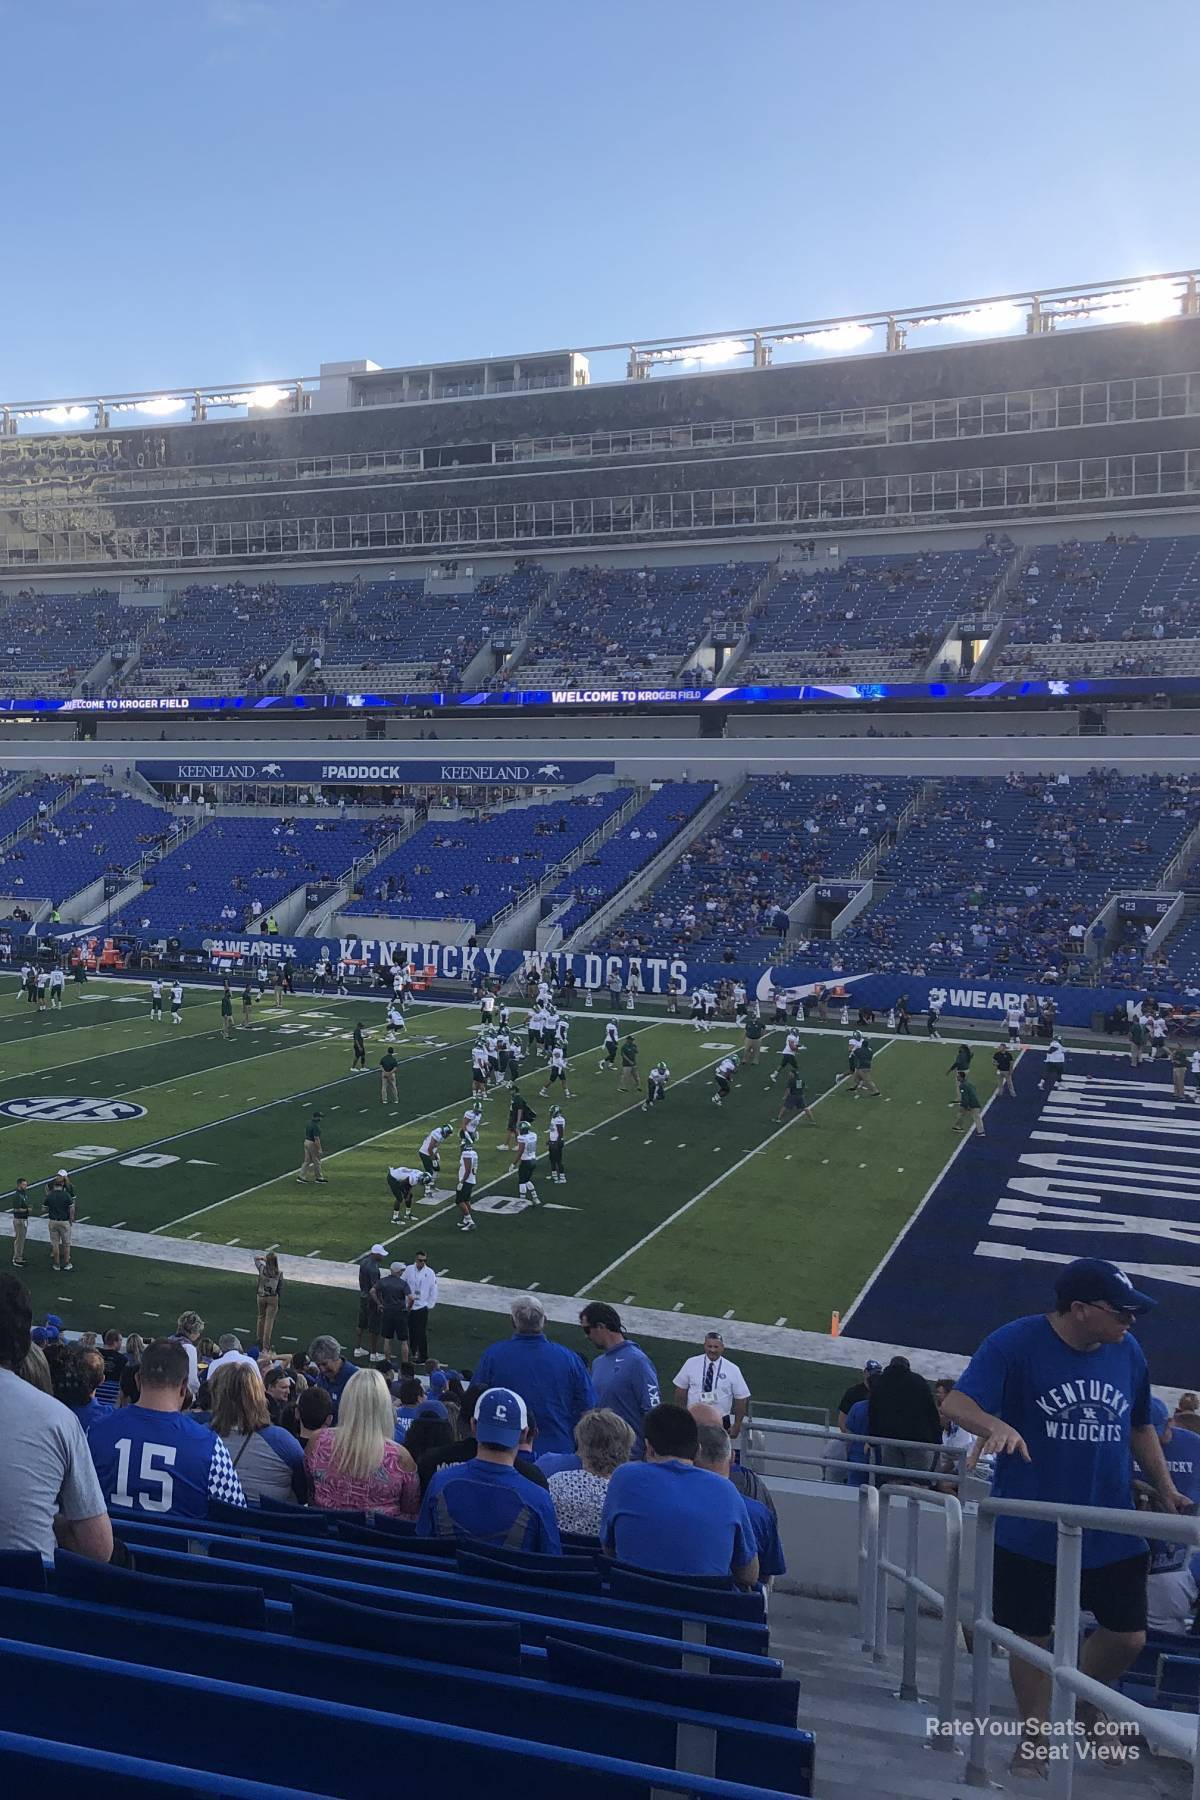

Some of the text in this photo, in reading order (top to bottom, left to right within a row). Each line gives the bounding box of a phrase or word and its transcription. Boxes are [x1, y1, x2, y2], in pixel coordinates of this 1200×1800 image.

[551, 690, 701, 703] WELCOME TO KROGER FIELD
[64, 699, 189, 709] WELCOME TO KROGER FIELD
[177, 765, 256, 778] KEENELAND
[327, 765, 400, 779] PADDOCK
[440, 766, 529, 779] KEENELAND
[822, 889, 831, 898] 24
[1125, 902, 1168, 913] 23 22
[339, 938, 502, 982] KENTUCKY
[53, 1145, 182, 1169] 20
[1035, 1379, 1130, 1418] KENTUCKY
[496, 1405, 507, 1418] C
[1045, 1420, 1122, 1442] WILDCATS
[110, 1438, 177, 1513] 15
